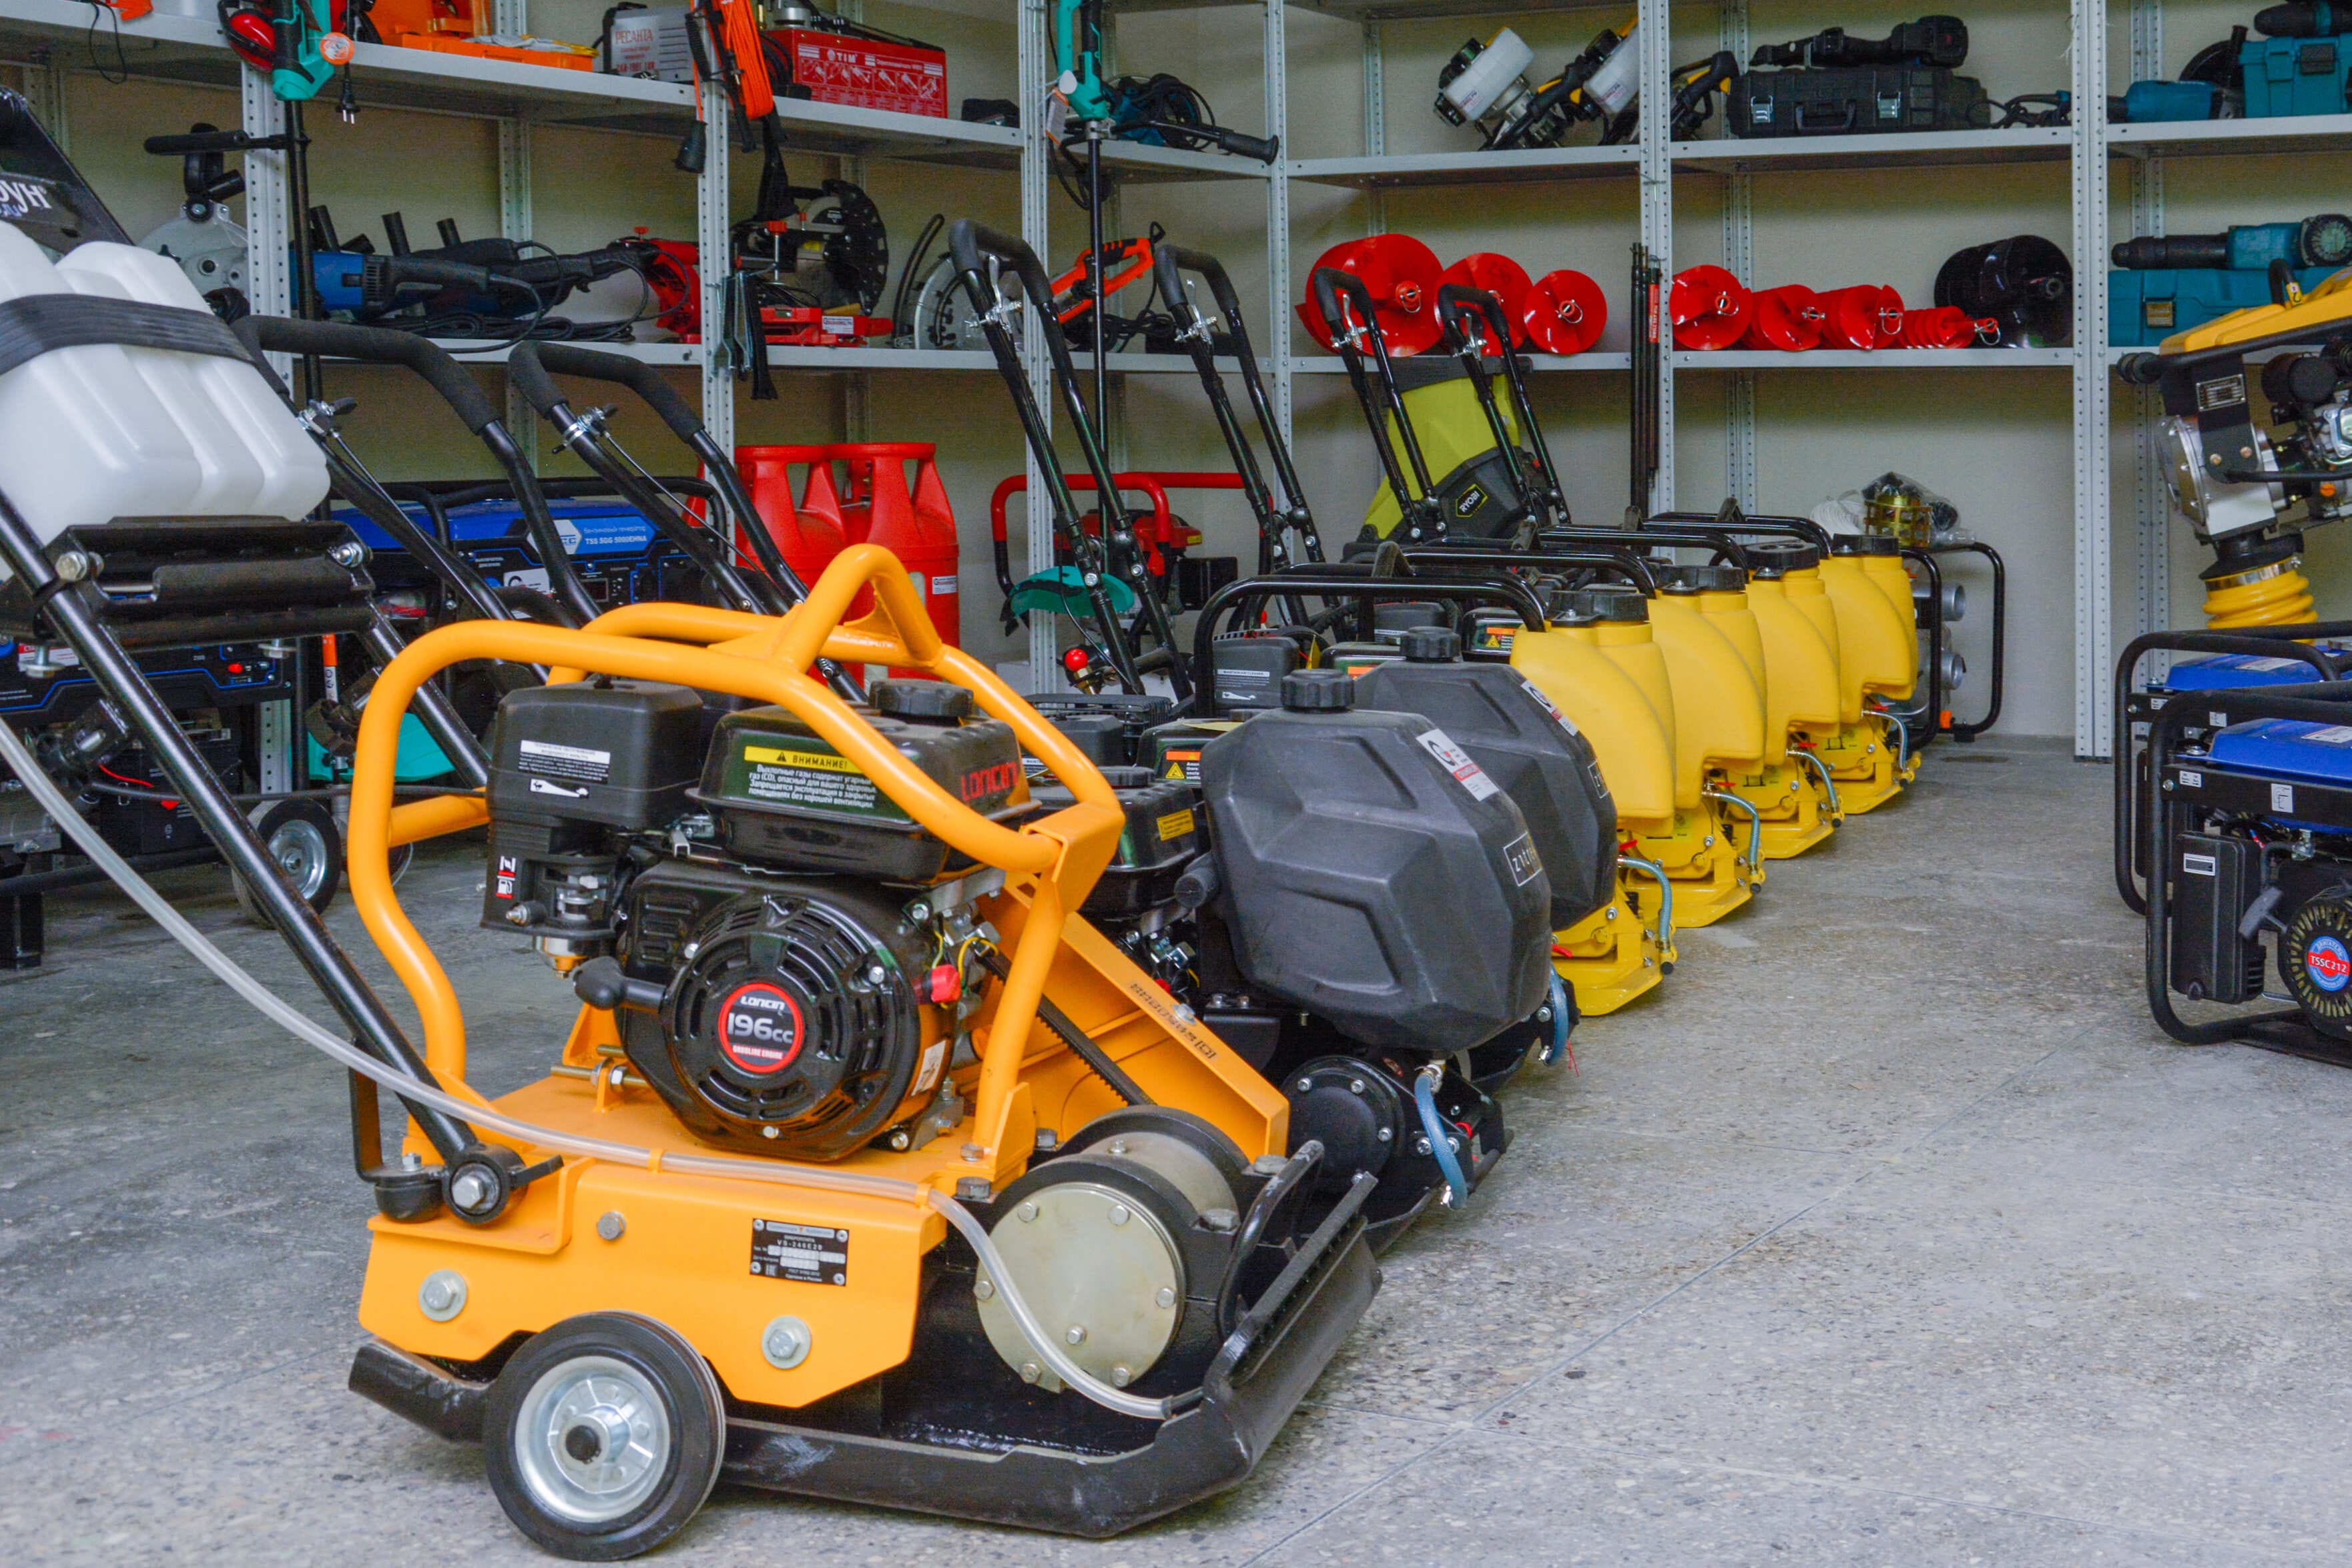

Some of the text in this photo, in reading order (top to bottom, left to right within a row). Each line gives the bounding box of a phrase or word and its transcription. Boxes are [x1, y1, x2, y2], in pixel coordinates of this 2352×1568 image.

[615, 29, 653, 43] РЕСАНТА
[838, 53, 857, 63] TIM
[1459, 490, 1480, 512] RYOBI
[793, 755, 848, 769] ВНИМАНИЕ!
[757, 763, 794, 776] Выхлопные
[796, 770, 812, 779] газы
[749, 772, 760, 780] газ
[777, 775, 806, 784] опасный
[806, 779, 820, 787] для
[820, 781, 844, 789] вашего
[791, 791, 803, 800] без
[804, 794, 833, 804] хорошей
[844, 791, 875, 801] закрытых
[2311, 955, 2347, 973] TSSC212
[727, 1012, 794, 1044] 196cc
